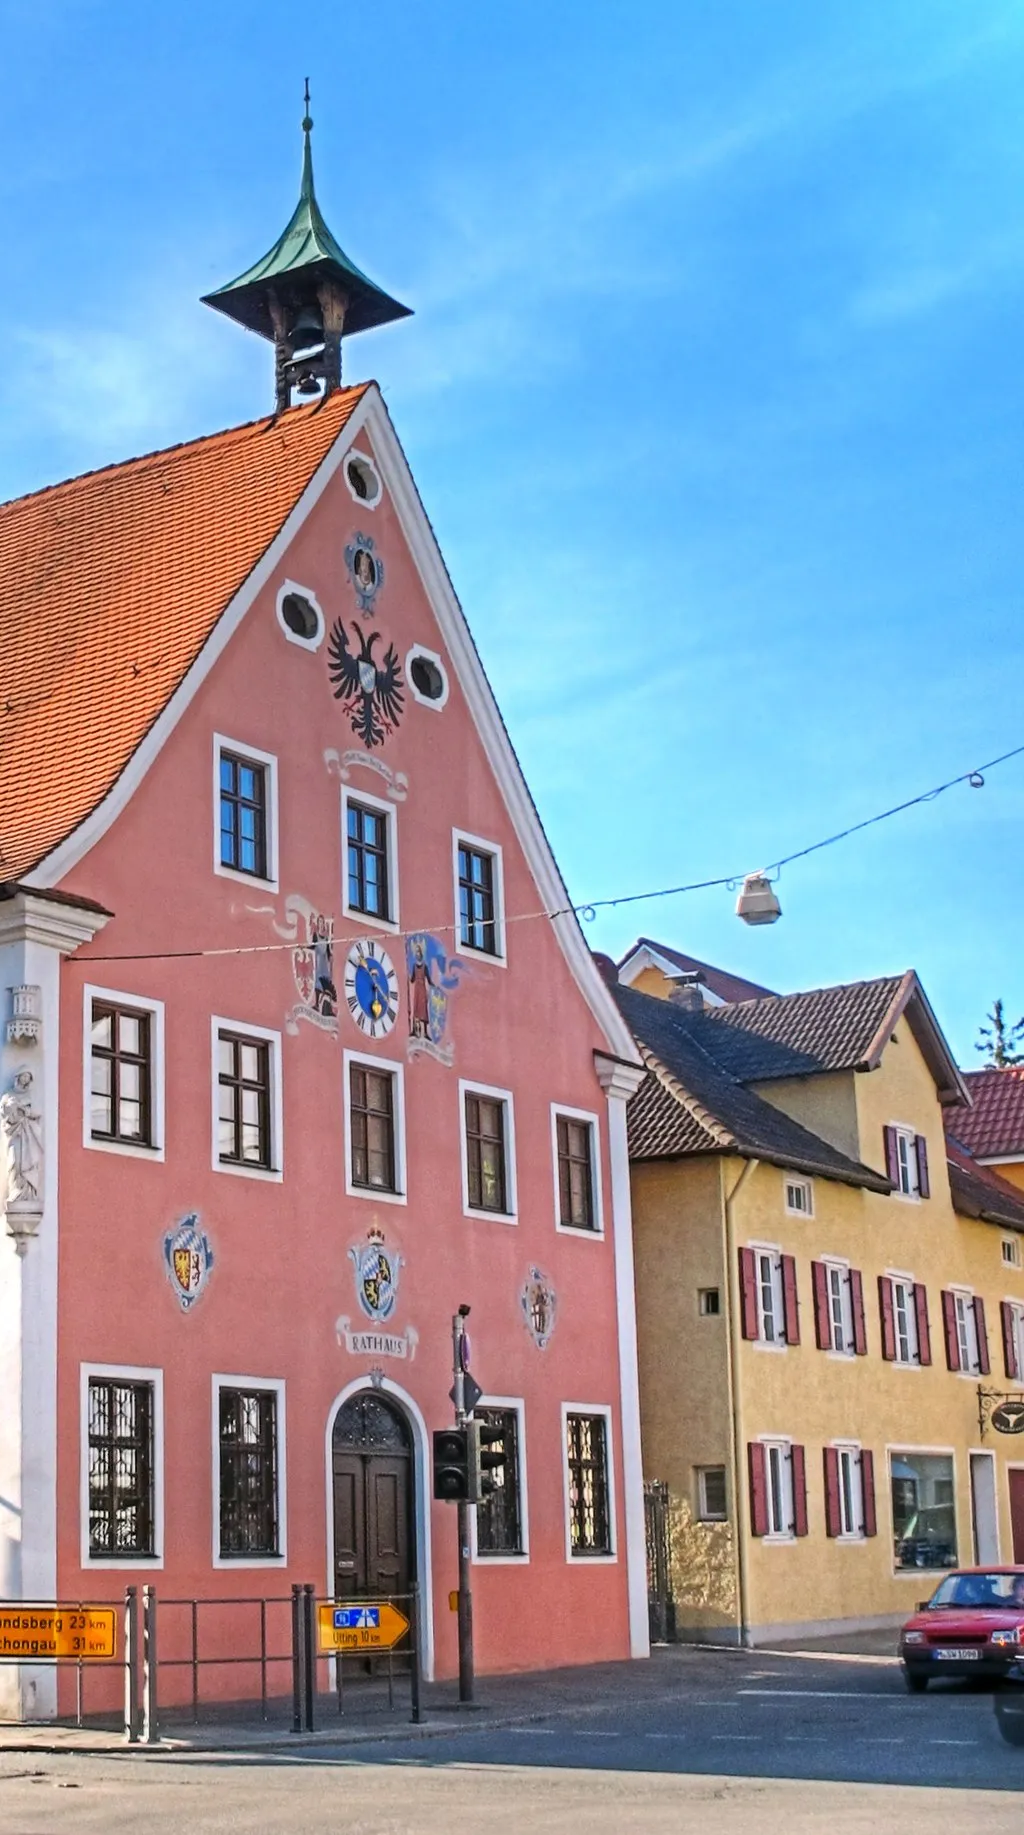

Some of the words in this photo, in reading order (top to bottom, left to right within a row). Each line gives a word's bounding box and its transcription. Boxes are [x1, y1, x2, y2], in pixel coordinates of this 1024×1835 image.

[352, 1335, 403, 1354] RATHAUS
[70, 1615, 87, 1630] 23
[89, 1619, 107, 1630] km
[72, 1636, 87, 1650] 31
[89, 1641, 107, 1651] km
[332, 1631, 358, 1649] Utting
[361, 1630, 370, 1644] 10
[371, 1633, 381, 1644] km
